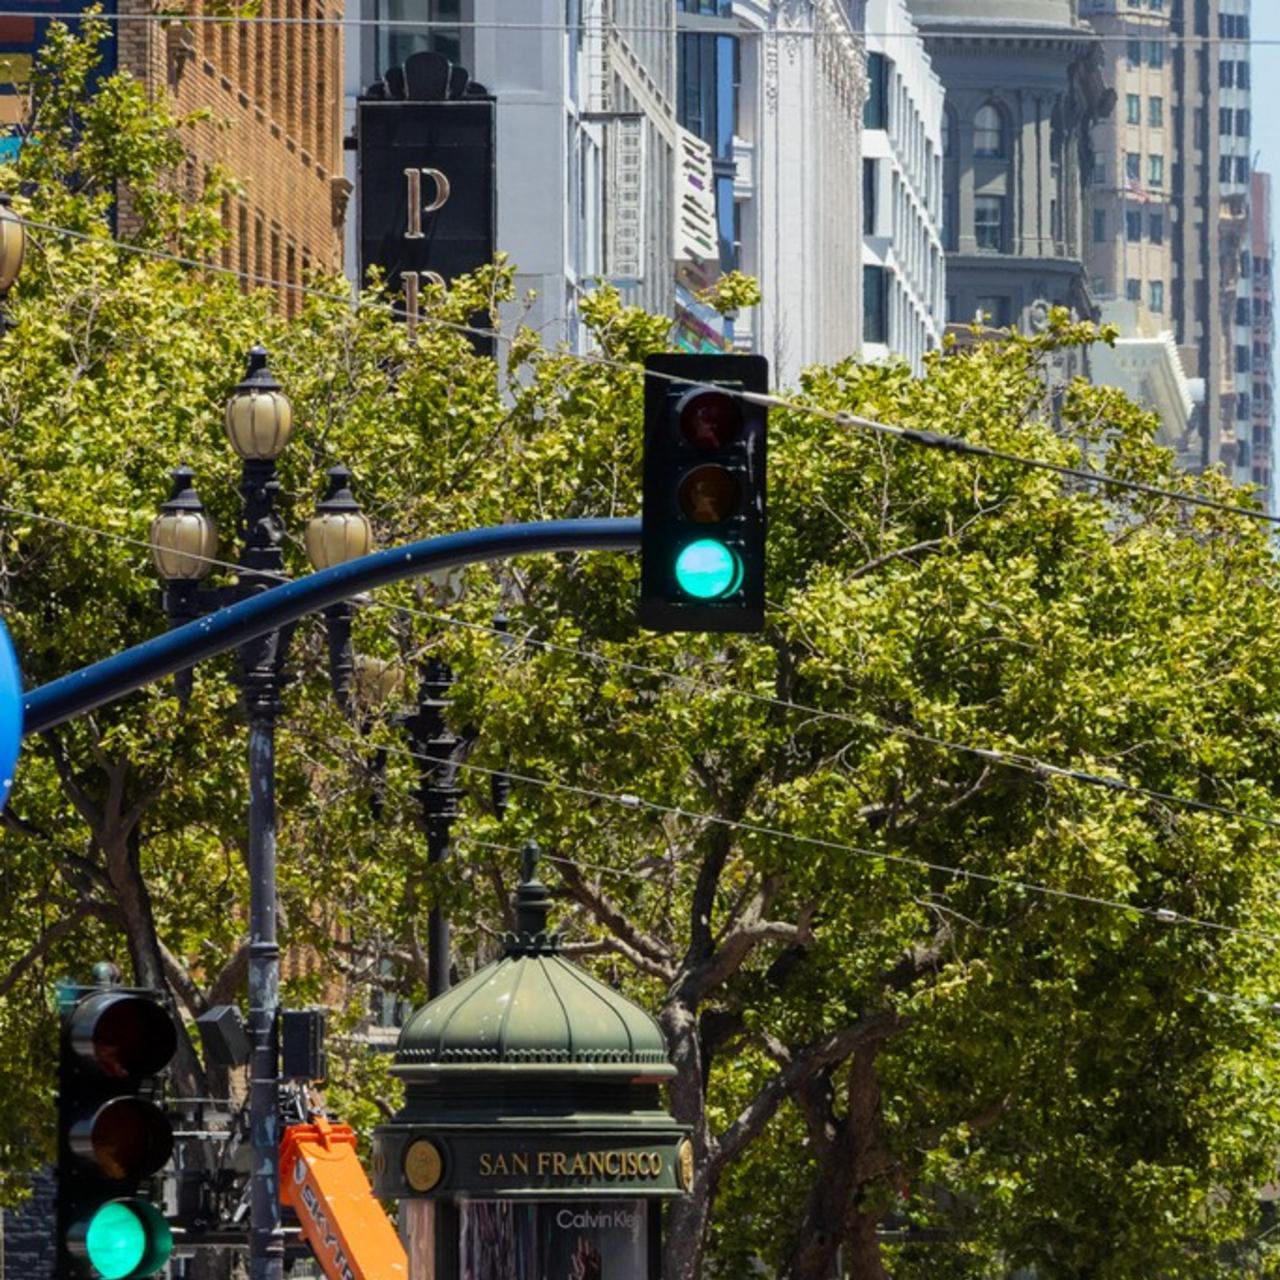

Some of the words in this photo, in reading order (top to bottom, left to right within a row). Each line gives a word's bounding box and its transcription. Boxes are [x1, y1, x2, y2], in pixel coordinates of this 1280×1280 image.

[479, 1152, 530, 1176] SAN
[536, 1151, 663, 1176] FRANCISCO
[556, 1209, 612, 1229] Calvin
